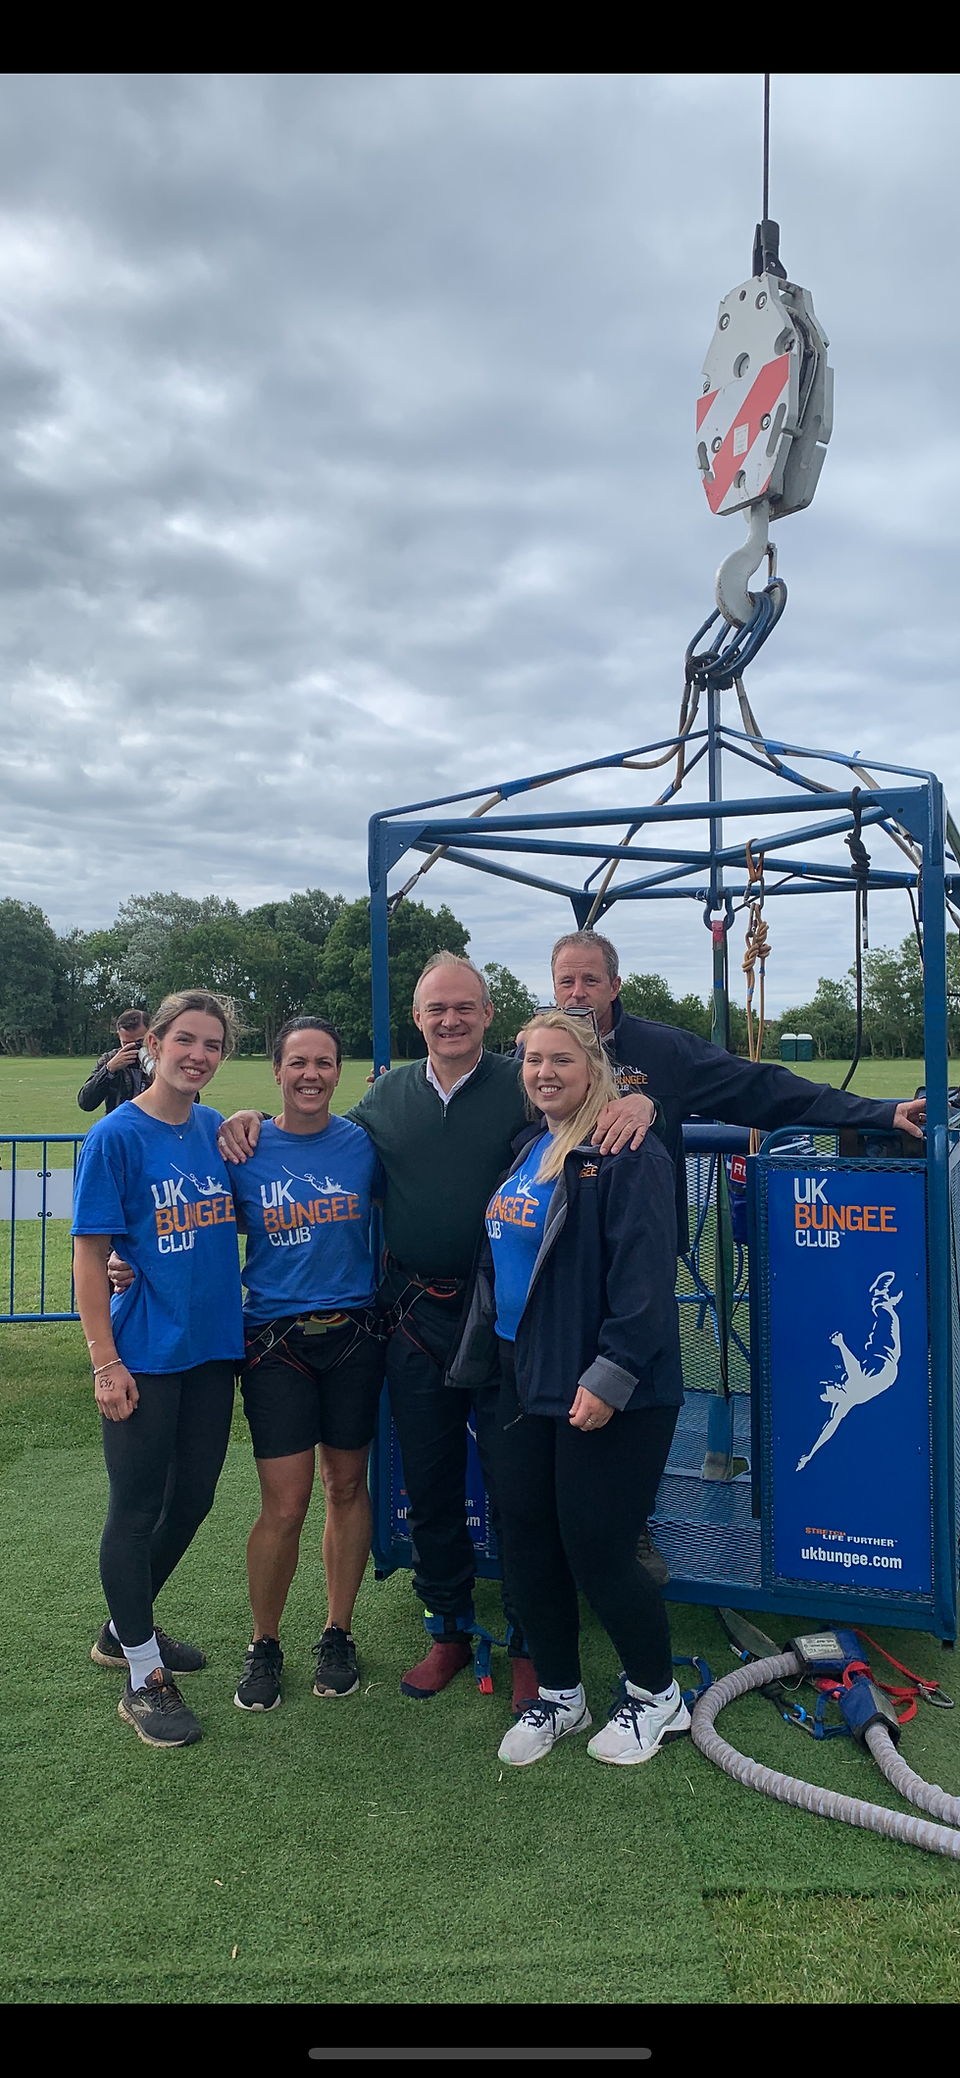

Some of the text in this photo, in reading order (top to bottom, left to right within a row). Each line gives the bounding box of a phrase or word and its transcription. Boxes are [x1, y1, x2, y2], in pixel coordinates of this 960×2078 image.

[151, 1177, 188, 1210] UK
[260, 1178, 295, 1209] UK
[793, 1177, 829, 1204] UK
[263, 1195, 361, 1233] BUNGEE
[485, 1194, 540, 1228] UNGEE
[794, 1203, 898, 1233] BUNGEE
[268, 1226, 312, 1247] CLUB
[795, 1229, 841, 1249] CLUB
[822, 1534, 895, 1547] LIFE FURTHER
[801, 1546, 902, 1569] ukbungee.com
